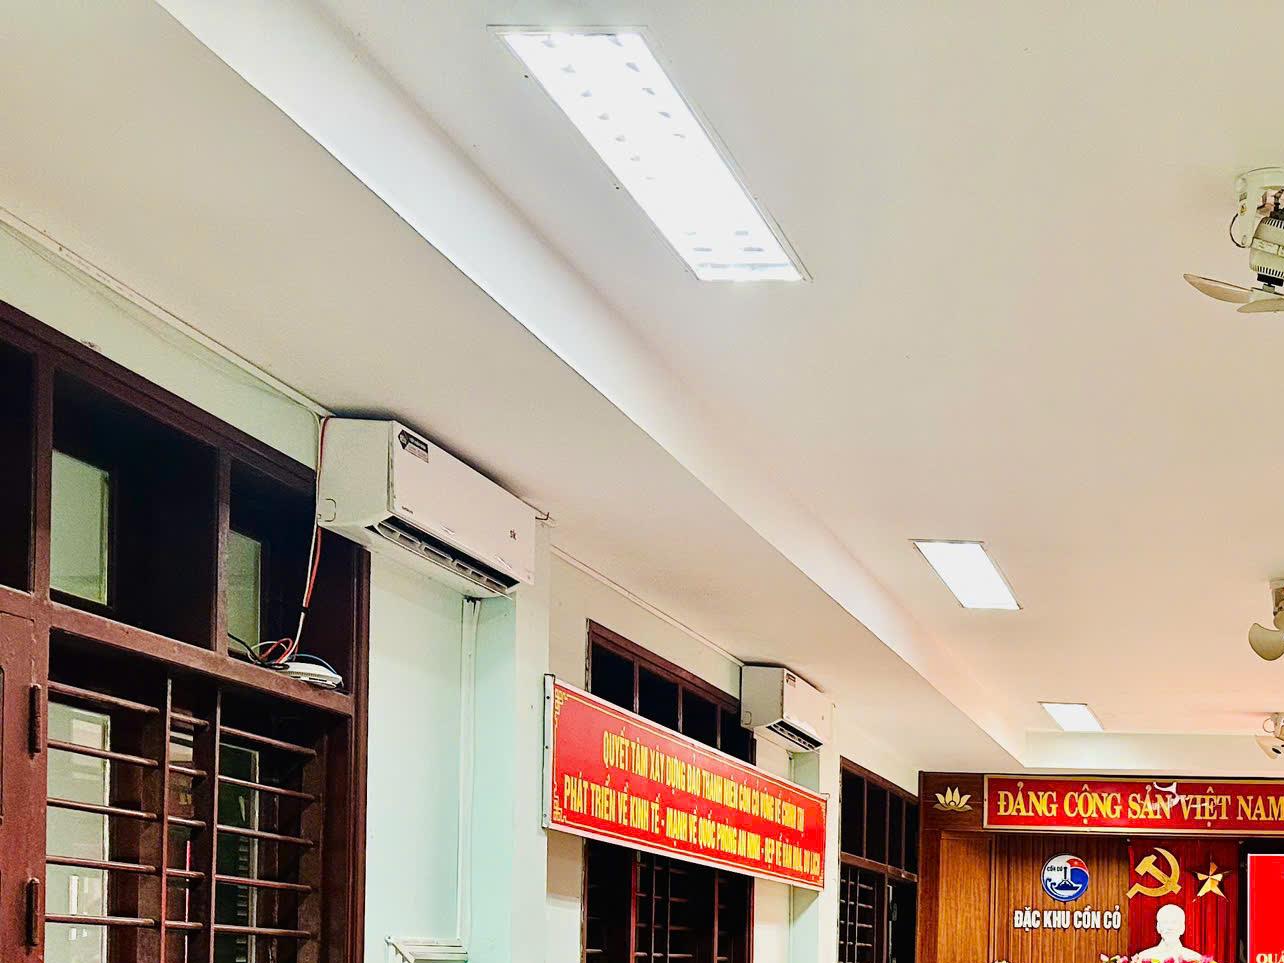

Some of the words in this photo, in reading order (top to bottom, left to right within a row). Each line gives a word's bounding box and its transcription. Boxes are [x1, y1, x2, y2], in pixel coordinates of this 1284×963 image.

[603, 726, 629, 771] QUYẾT
[631, 736, 649, 778] TÂM
[649, 745, 665, 784] XÂY
[564, 771, 588, 815] PHÁT
[590, 774, 616, 823] TRIỂN
[618, 782, 628, 826] VỀ
[630, 795, 649, 832] KINH
[651, 793, 660, 834] TẾ
[997, 781, 1058, 817] ĐẢNG
[1063, 784, 1122, 824] CỘNG
[1127, 785, 1171, 820] SẢN
[1179, 786, 1231, 828] VIỆT
[1014, 906, 1041, 931] ĐẶC
[1043, 910, 1070, 929] KHU
[1073, 905, 1100, 929] CỒN
[1103, 905, 1121, 929] CỎ
